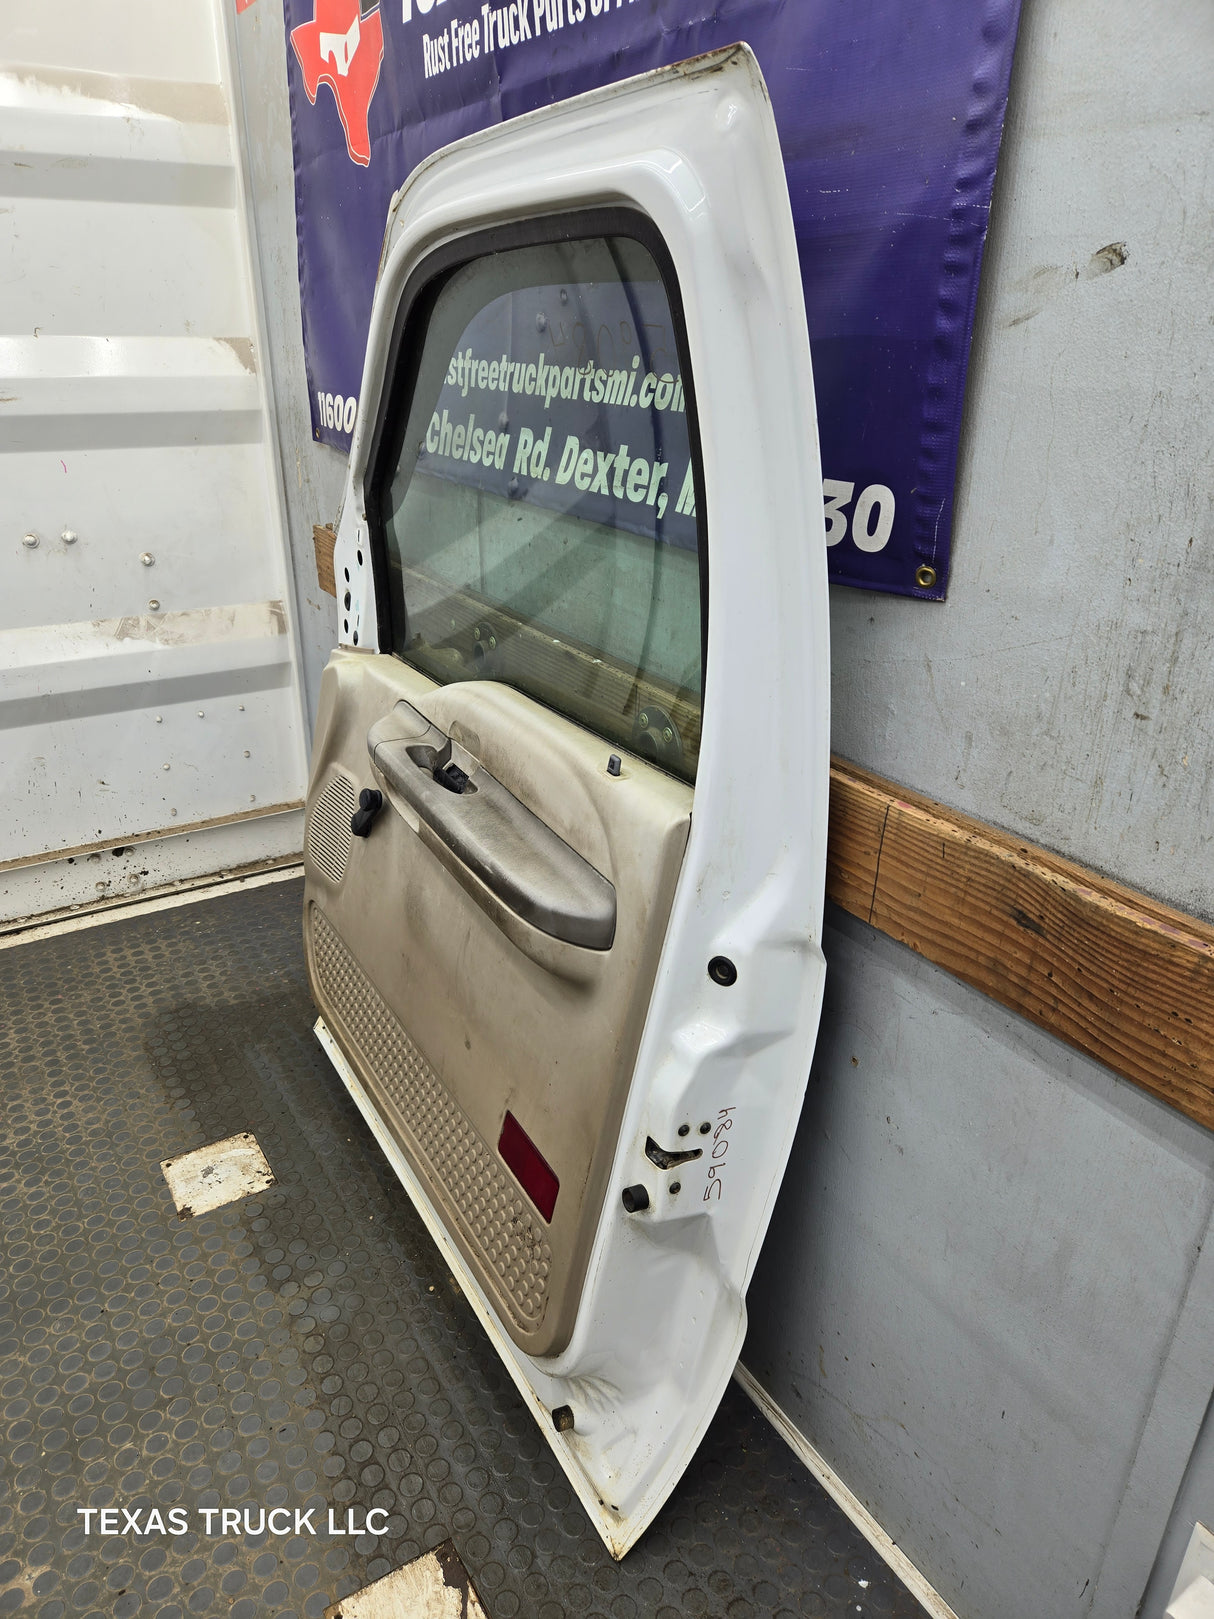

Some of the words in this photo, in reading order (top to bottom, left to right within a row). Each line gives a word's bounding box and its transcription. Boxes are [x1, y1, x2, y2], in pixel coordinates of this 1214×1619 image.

[422, 27, 451, 79] Rust
[450, 17, 481, 68] Free
[481, 0, 533, 54] Truck
[444, 347, 686, 412] stfreetruckpartsmi.co
[317, 391, 357, 434] 11600
[425, 409, 511, 470] Chelsea
[512, 426, 553, 482] Rd.
[554, 434, 669, 519] Dexter,
[703, 1106, 737, 1202] 59084
